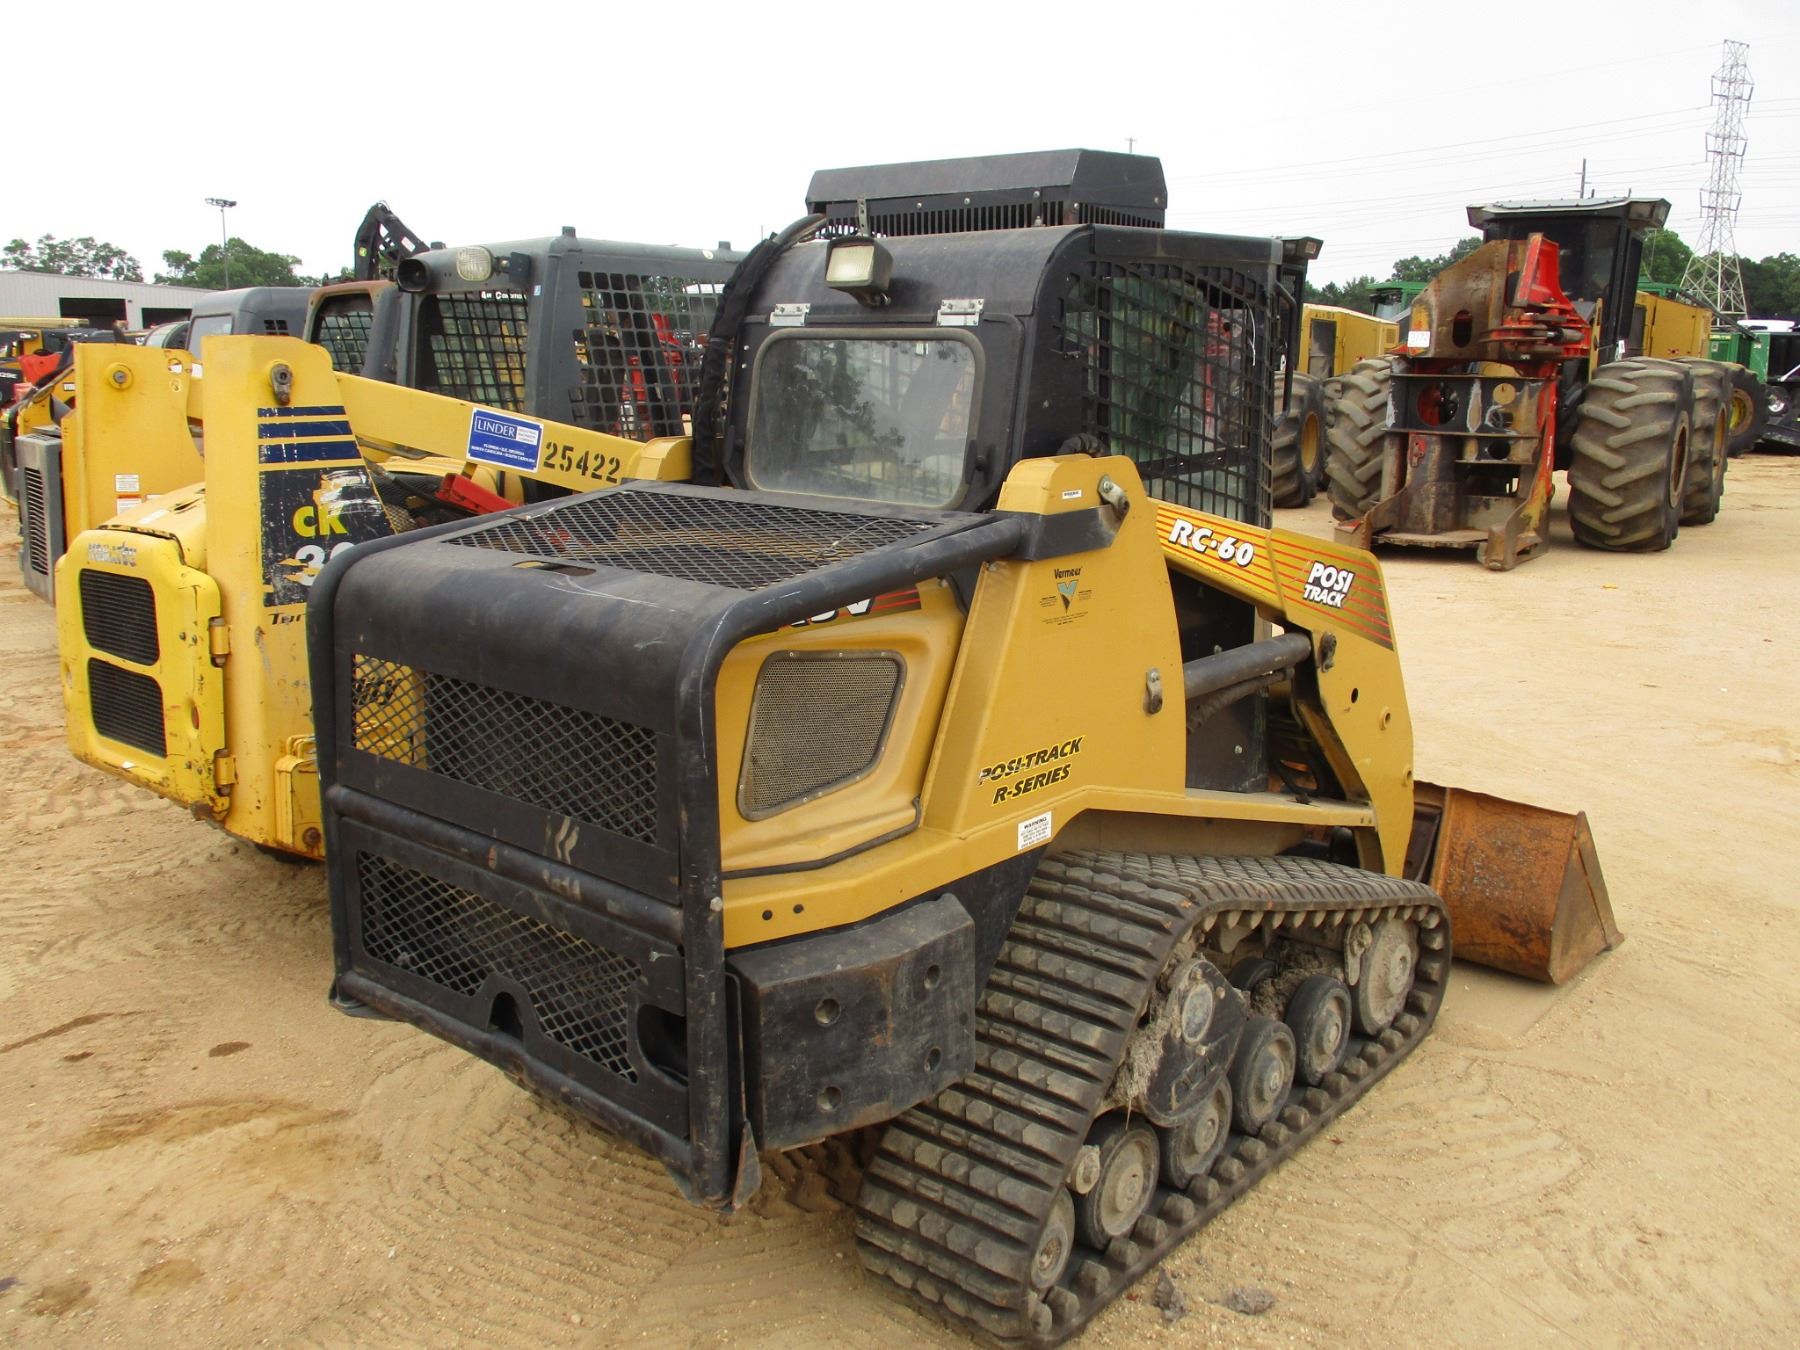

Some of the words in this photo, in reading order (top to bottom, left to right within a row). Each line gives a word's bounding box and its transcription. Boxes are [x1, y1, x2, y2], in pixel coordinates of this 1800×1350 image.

[478, 420, 514, 437] LINDER
[543, 441, 620, 483] 25422
[1308, 561, 1354, 594] POSI
[1303, 584, 1345, 609] TRACK
[978, 736, 1084, 786] POSI-TRACK
[992, 763, 1071, 806] R-SERIES
